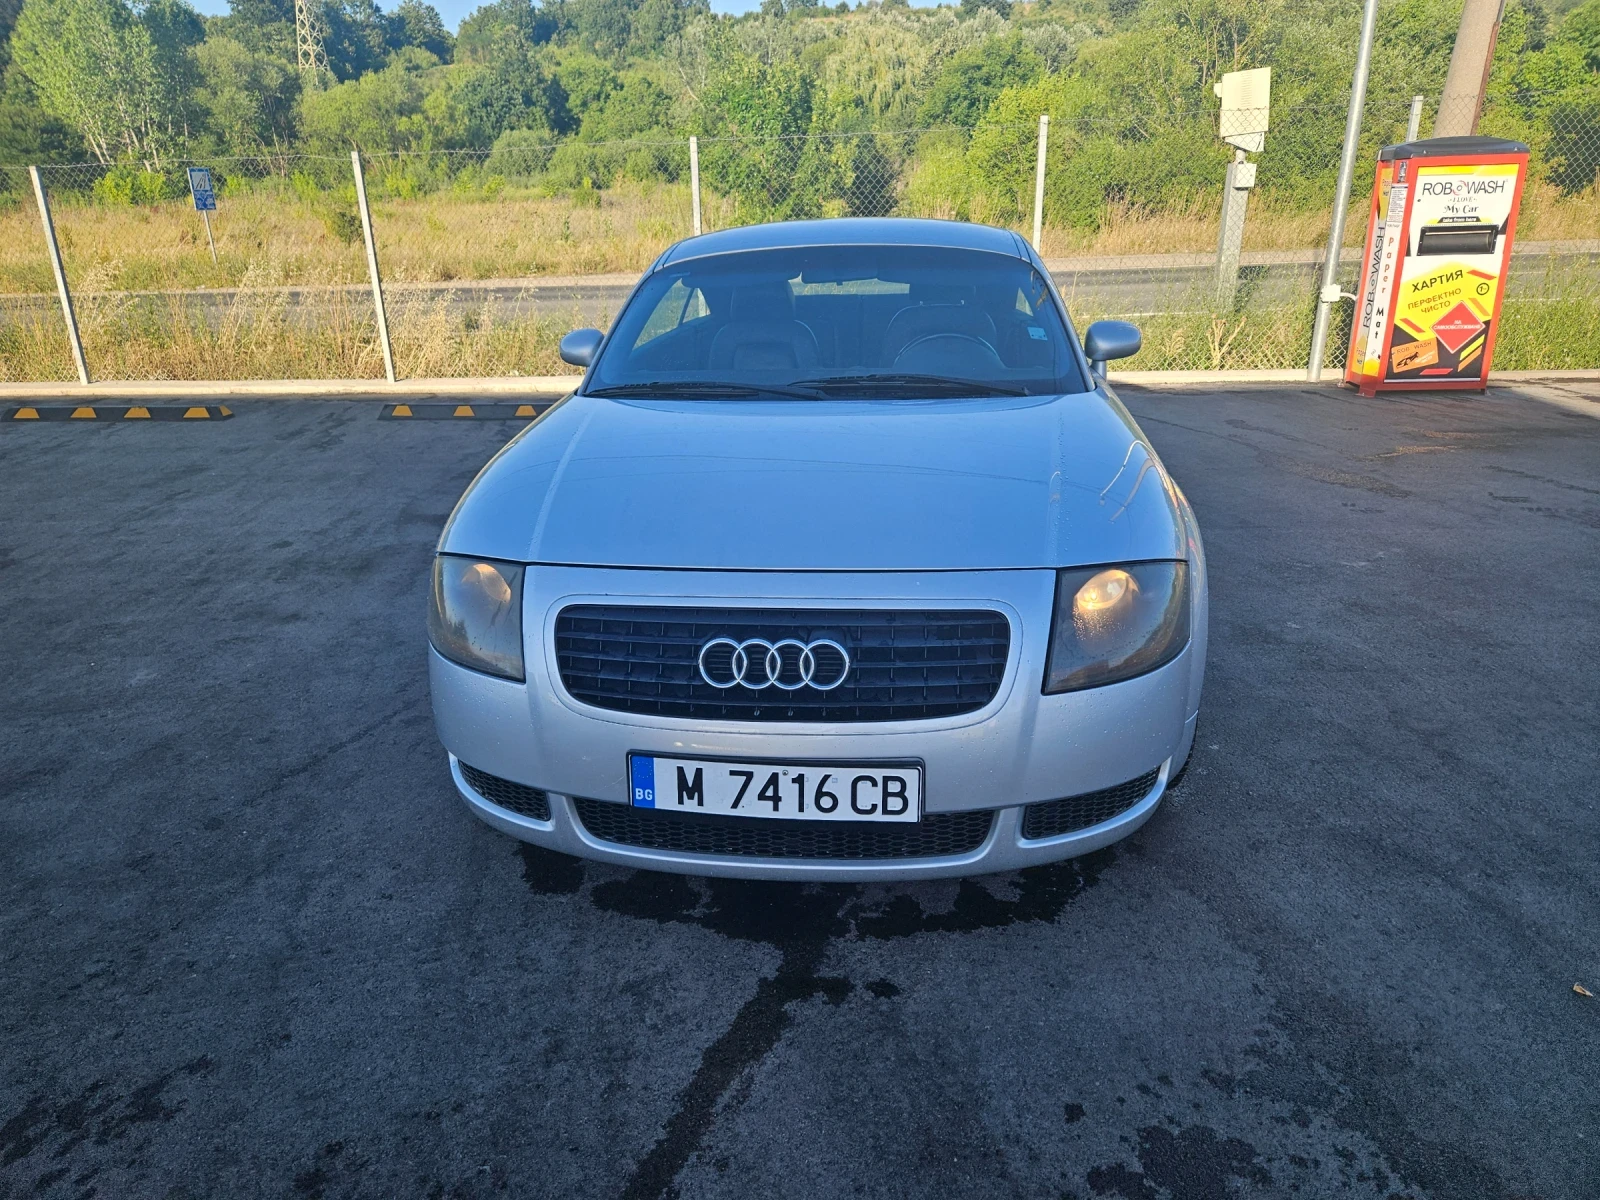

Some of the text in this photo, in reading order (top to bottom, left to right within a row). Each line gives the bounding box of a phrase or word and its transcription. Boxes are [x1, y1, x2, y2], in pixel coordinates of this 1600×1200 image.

[1443, 203, 1480, 215] My Car
[1412, 269, 1464, 293] ХАРТИЯ
[1407, 287, 1462, 310] ПЕРФЕКТНО
[1421, 300, 1451, 314] ЧИСТО
[1413, 341, 1432, 350] WASH
[635, 788, 653, 801] BG
[676, 765, 909, 816] M 7416 CB
